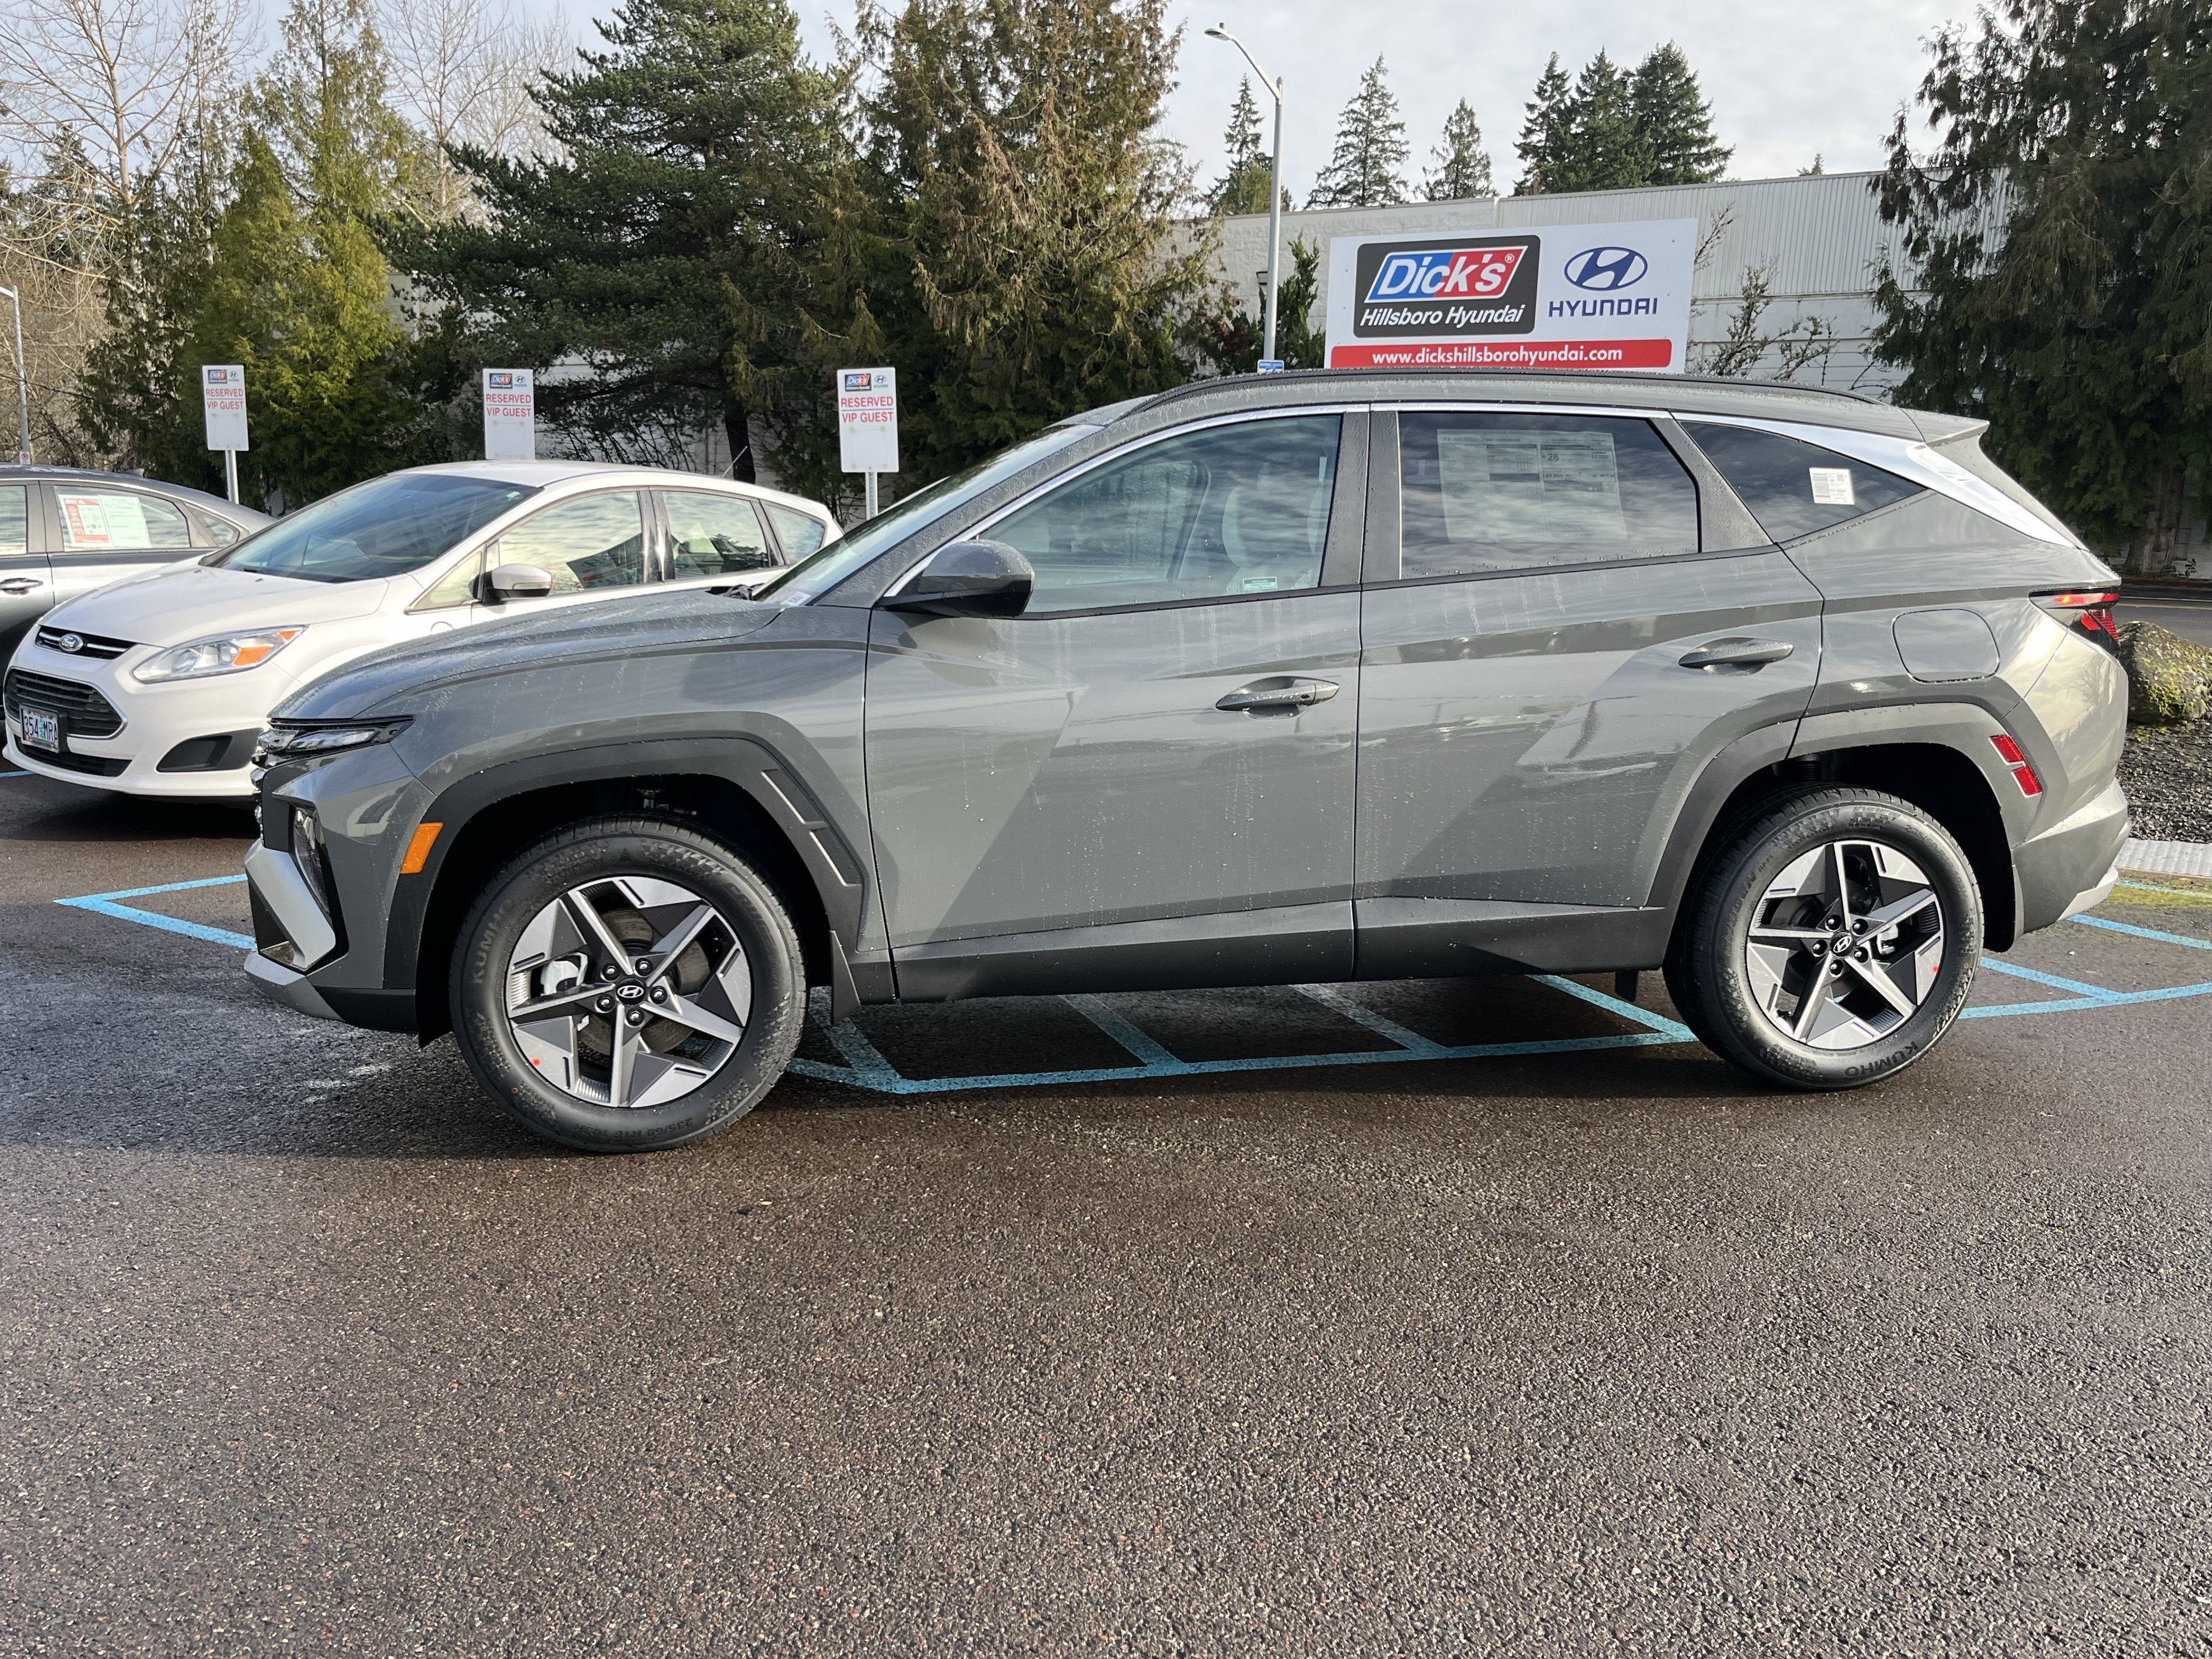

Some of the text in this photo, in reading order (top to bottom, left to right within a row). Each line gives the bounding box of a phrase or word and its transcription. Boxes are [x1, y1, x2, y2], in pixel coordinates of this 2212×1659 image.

[1549, 297, 1657, 318] HYUNDAI
[1360, 304, 1526, 329] Hillsboro Hyundai
[1372, 346, 1622, 366] www.dickshillsborohyundai.com
[206, 388, 243, 397] RESERVED
[486, 394, 532, 404] RESERVED
[840, 396, 894, 408] RESERVED
[207, 401, 244, 410] VIP GUEST
[487, 407, 532, 417] VIP GUEST
[842, 411, 894, 423] VIP GUEST
[24, 715, 39, 737] 354
[1844, 1041, 1918, 1077] KUMHO
